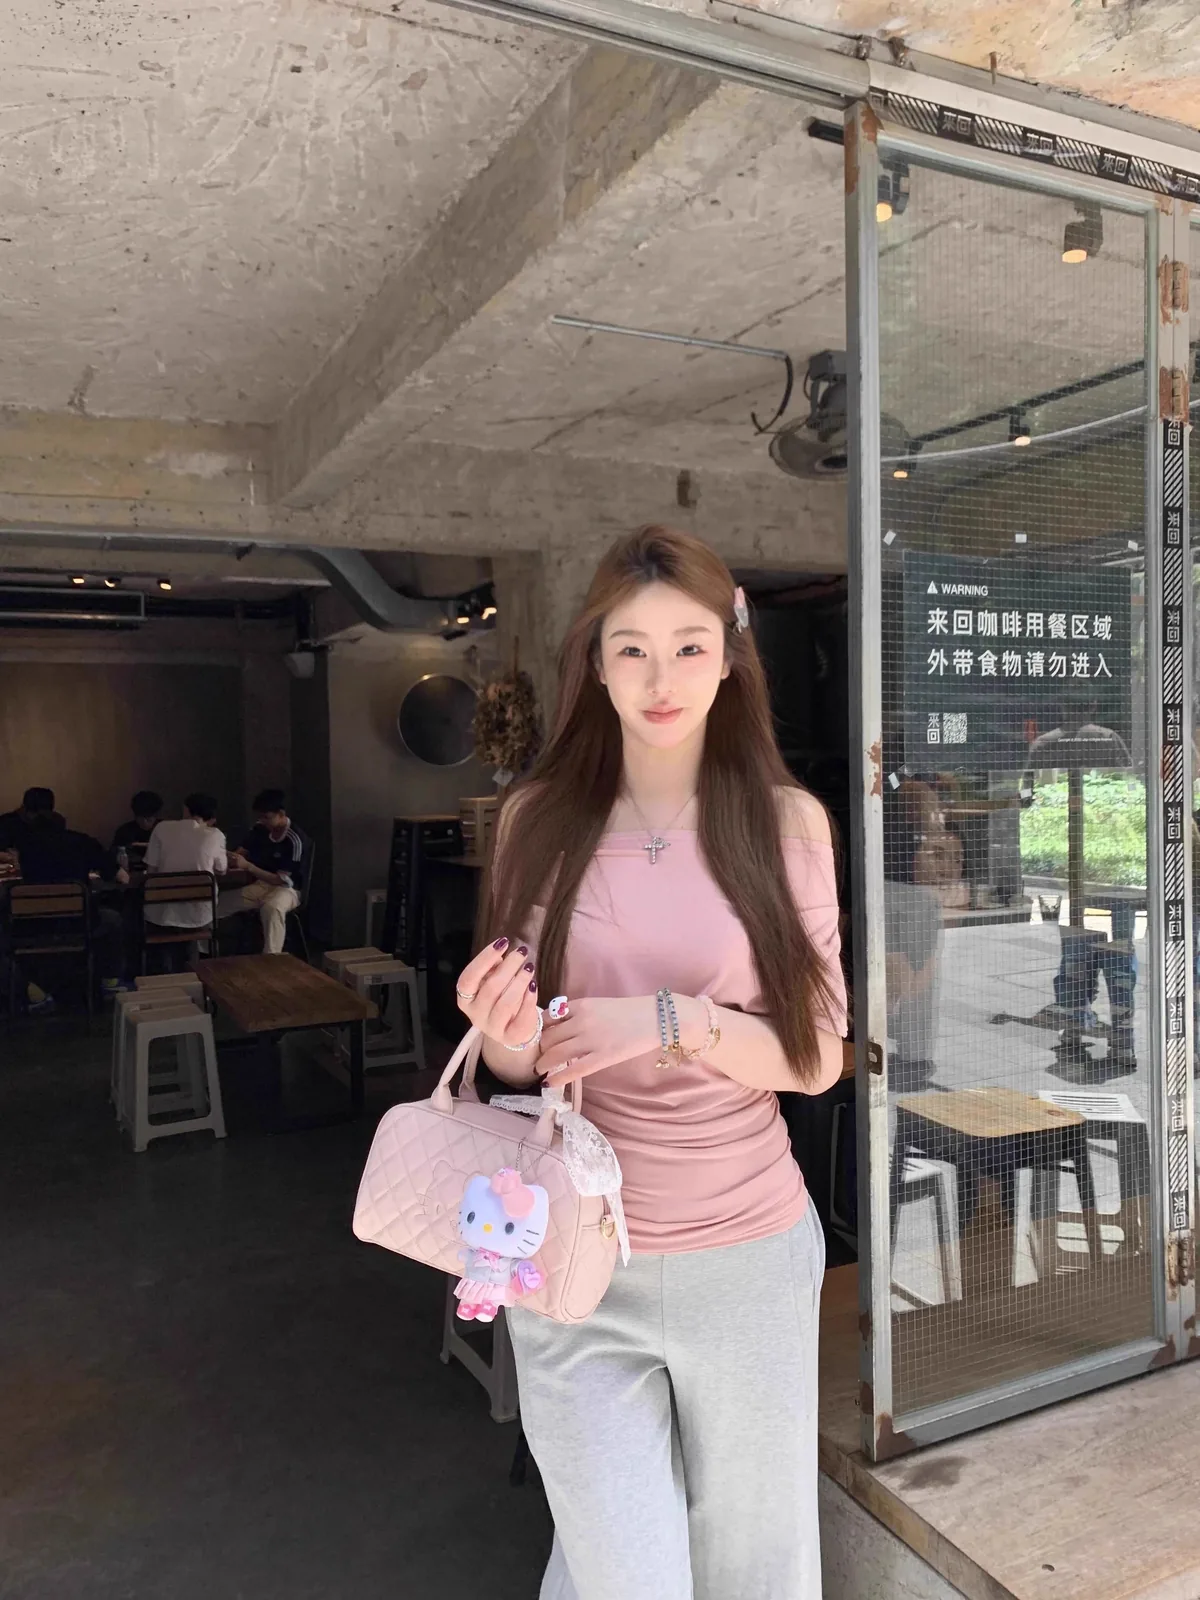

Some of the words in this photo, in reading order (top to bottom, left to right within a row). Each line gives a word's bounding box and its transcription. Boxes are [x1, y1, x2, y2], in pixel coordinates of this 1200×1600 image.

[941, 583, 989, 597] WARNING
[927, 607, 1113, 641] 来回咖啡用餐区域
[927, 648, 1113, 678] 外带食物请勿进入
